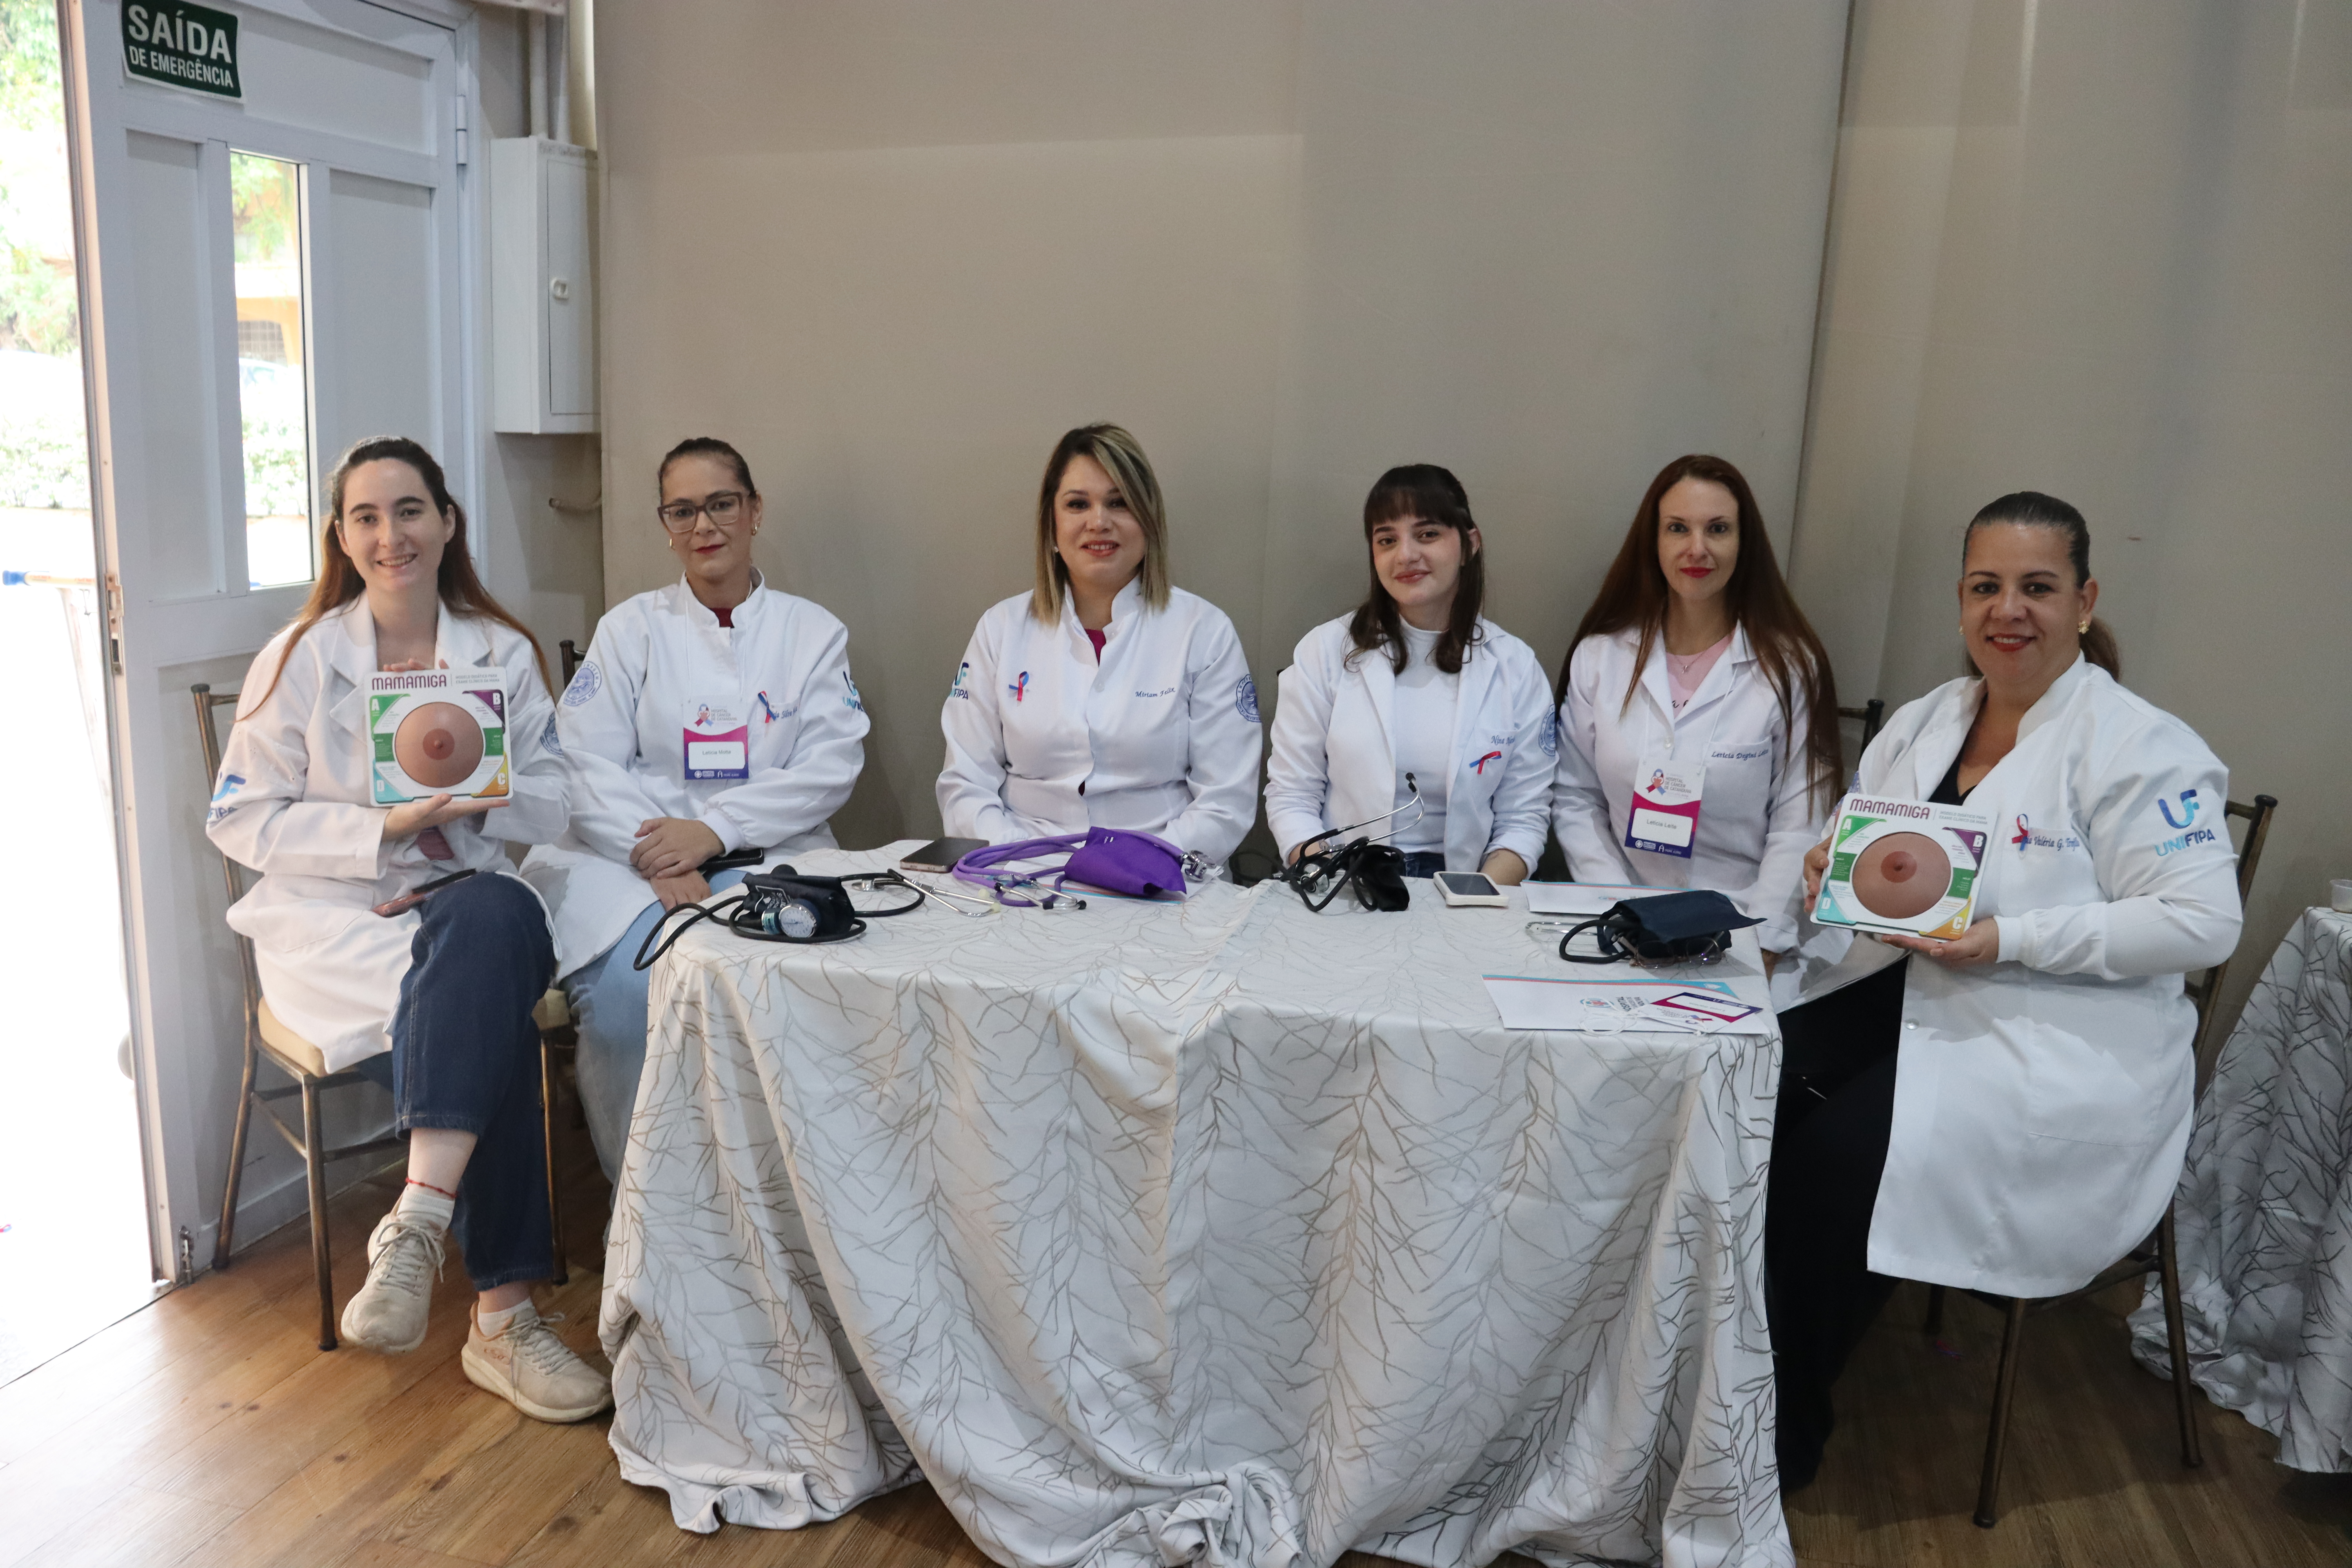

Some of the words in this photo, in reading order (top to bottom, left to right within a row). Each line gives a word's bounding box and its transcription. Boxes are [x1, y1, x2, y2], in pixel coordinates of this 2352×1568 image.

[128, 4, 232, 64] SAÍDA
[129, 45, 147, 68] DE
[150, 51, 234, 88] EMERGÊNCIA
[372, 675, 446, 690] MAMAMIGA
[372, 699, 380, 711] A
[493, 692, 501, 705] B
[497, 773, 506, 785] C
[1849, 799, 1930, 820] MAMAMIGA
[1842, 818, 1852, 830] A
[1973, 835, 1984, 847] B
[2154, 829, 2216, 856] UNIFIPA
[1821, 897, 1832, 909] D
[1953, 916, 1964, 929] C
